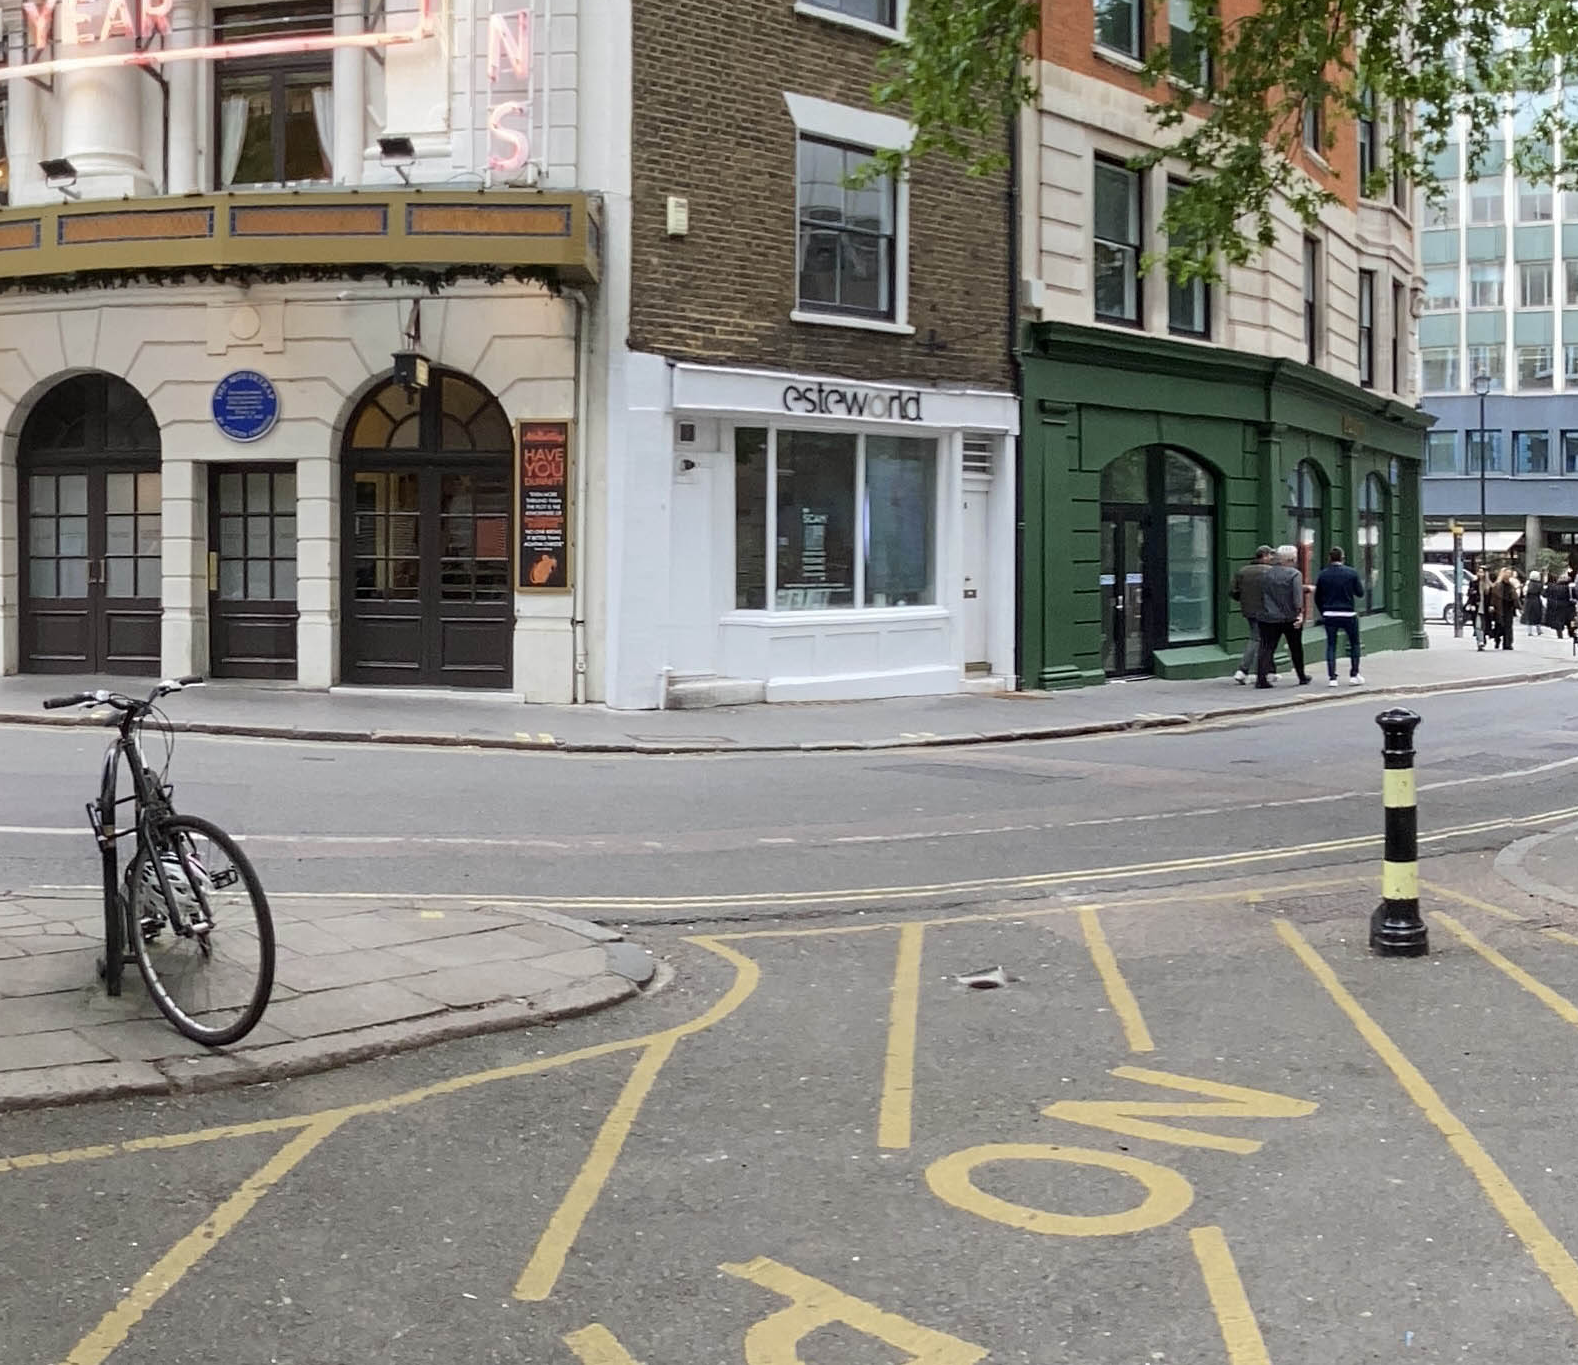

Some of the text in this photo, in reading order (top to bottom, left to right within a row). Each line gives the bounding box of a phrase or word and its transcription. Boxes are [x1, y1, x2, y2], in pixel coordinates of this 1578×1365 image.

[782, 382, 924, 422] esteworld
[524, 448, 564, 462] HAVE
[524, 461, 564, 477] YOU
[524, 477, 564, 487] DUNNIT?
